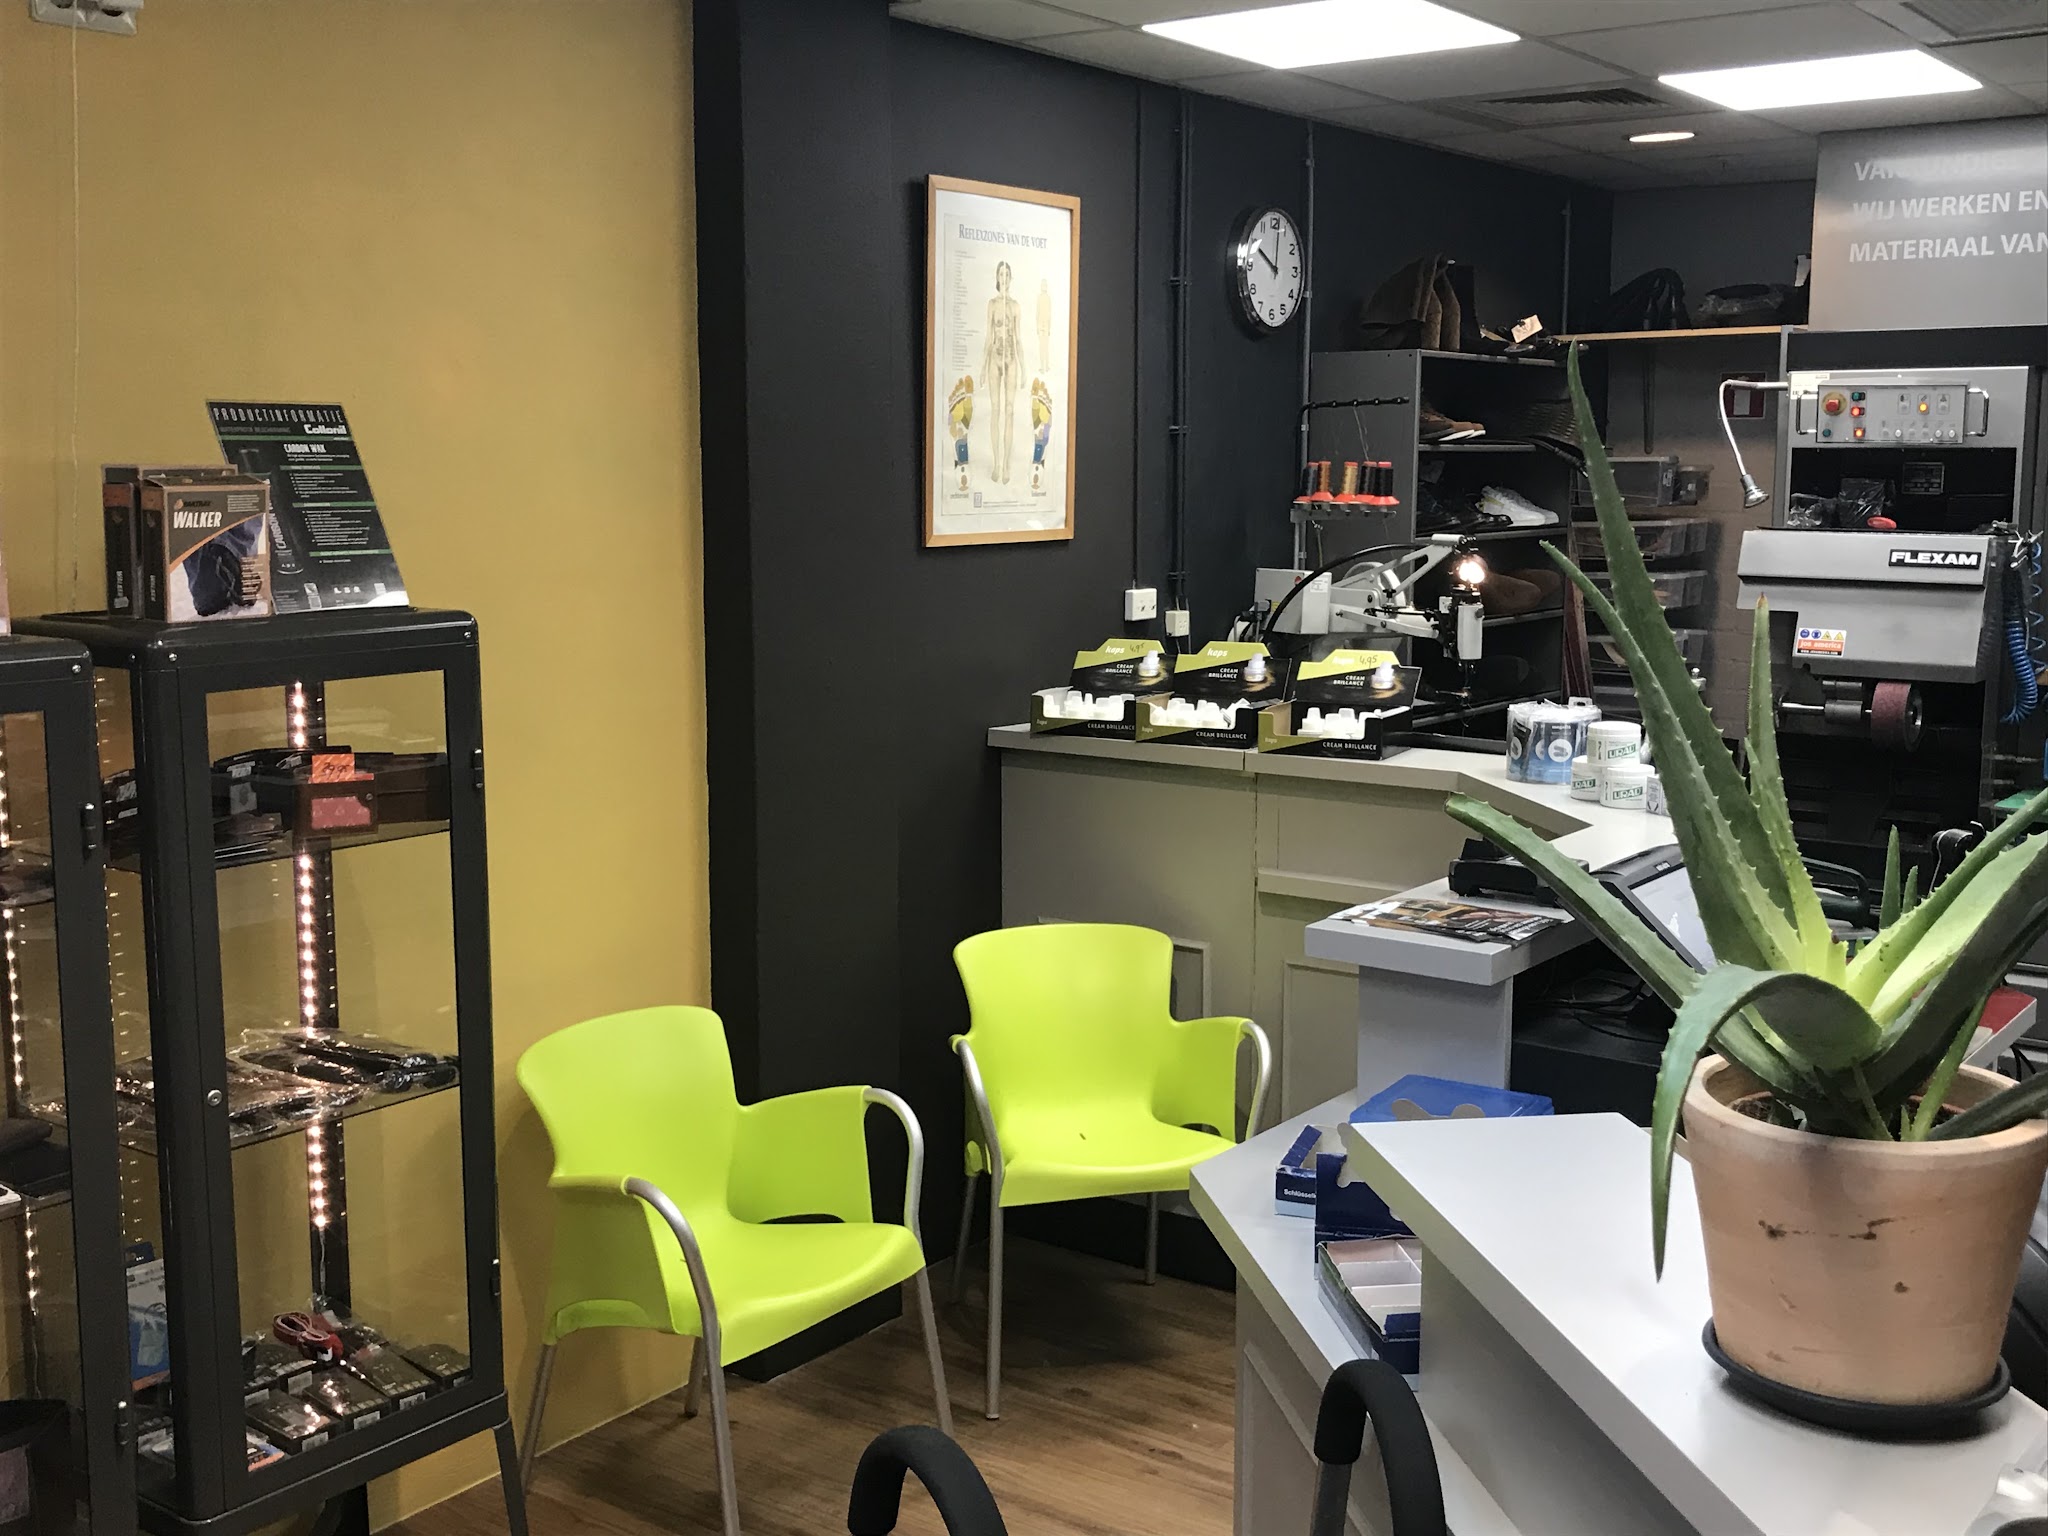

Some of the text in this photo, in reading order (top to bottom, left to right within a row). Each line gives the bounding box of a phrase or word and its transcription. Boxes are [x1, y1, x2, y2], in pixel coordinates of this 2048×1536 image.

[1853, 200, 1895, 221] WIJ
[1901, 192, 2011, 219] WERKEN
[1006, 233, 1020, 246] VAN
[1021, 235, 1030, 247] DE
[1031, 237, 1048, 249] VOET
[1289, 244, 1296, 256] 2
[1849, 236, 1995, 263] MATERIAAL
[1291, 266, 1298, 278] 3
[1249, 283, 1256, 295] 8
[1288, 289, 1294, 300] 4
[1258, 301, 1264, 313] 7
[1279, 304, 1286, 316] 5
[1268, 309, 1275, 320] 6
[213, 407, 344, 423] PRODUCTINFORMATIE
[303, 424, 347, 435] Collonil
[173, 511, 222, 529] WALKER
[1891, 552, 1978, 566] FLEXAM
[1344, 743, 1377, 751] BRILLANCE
[1614, 787, 1642, 800] URAD
